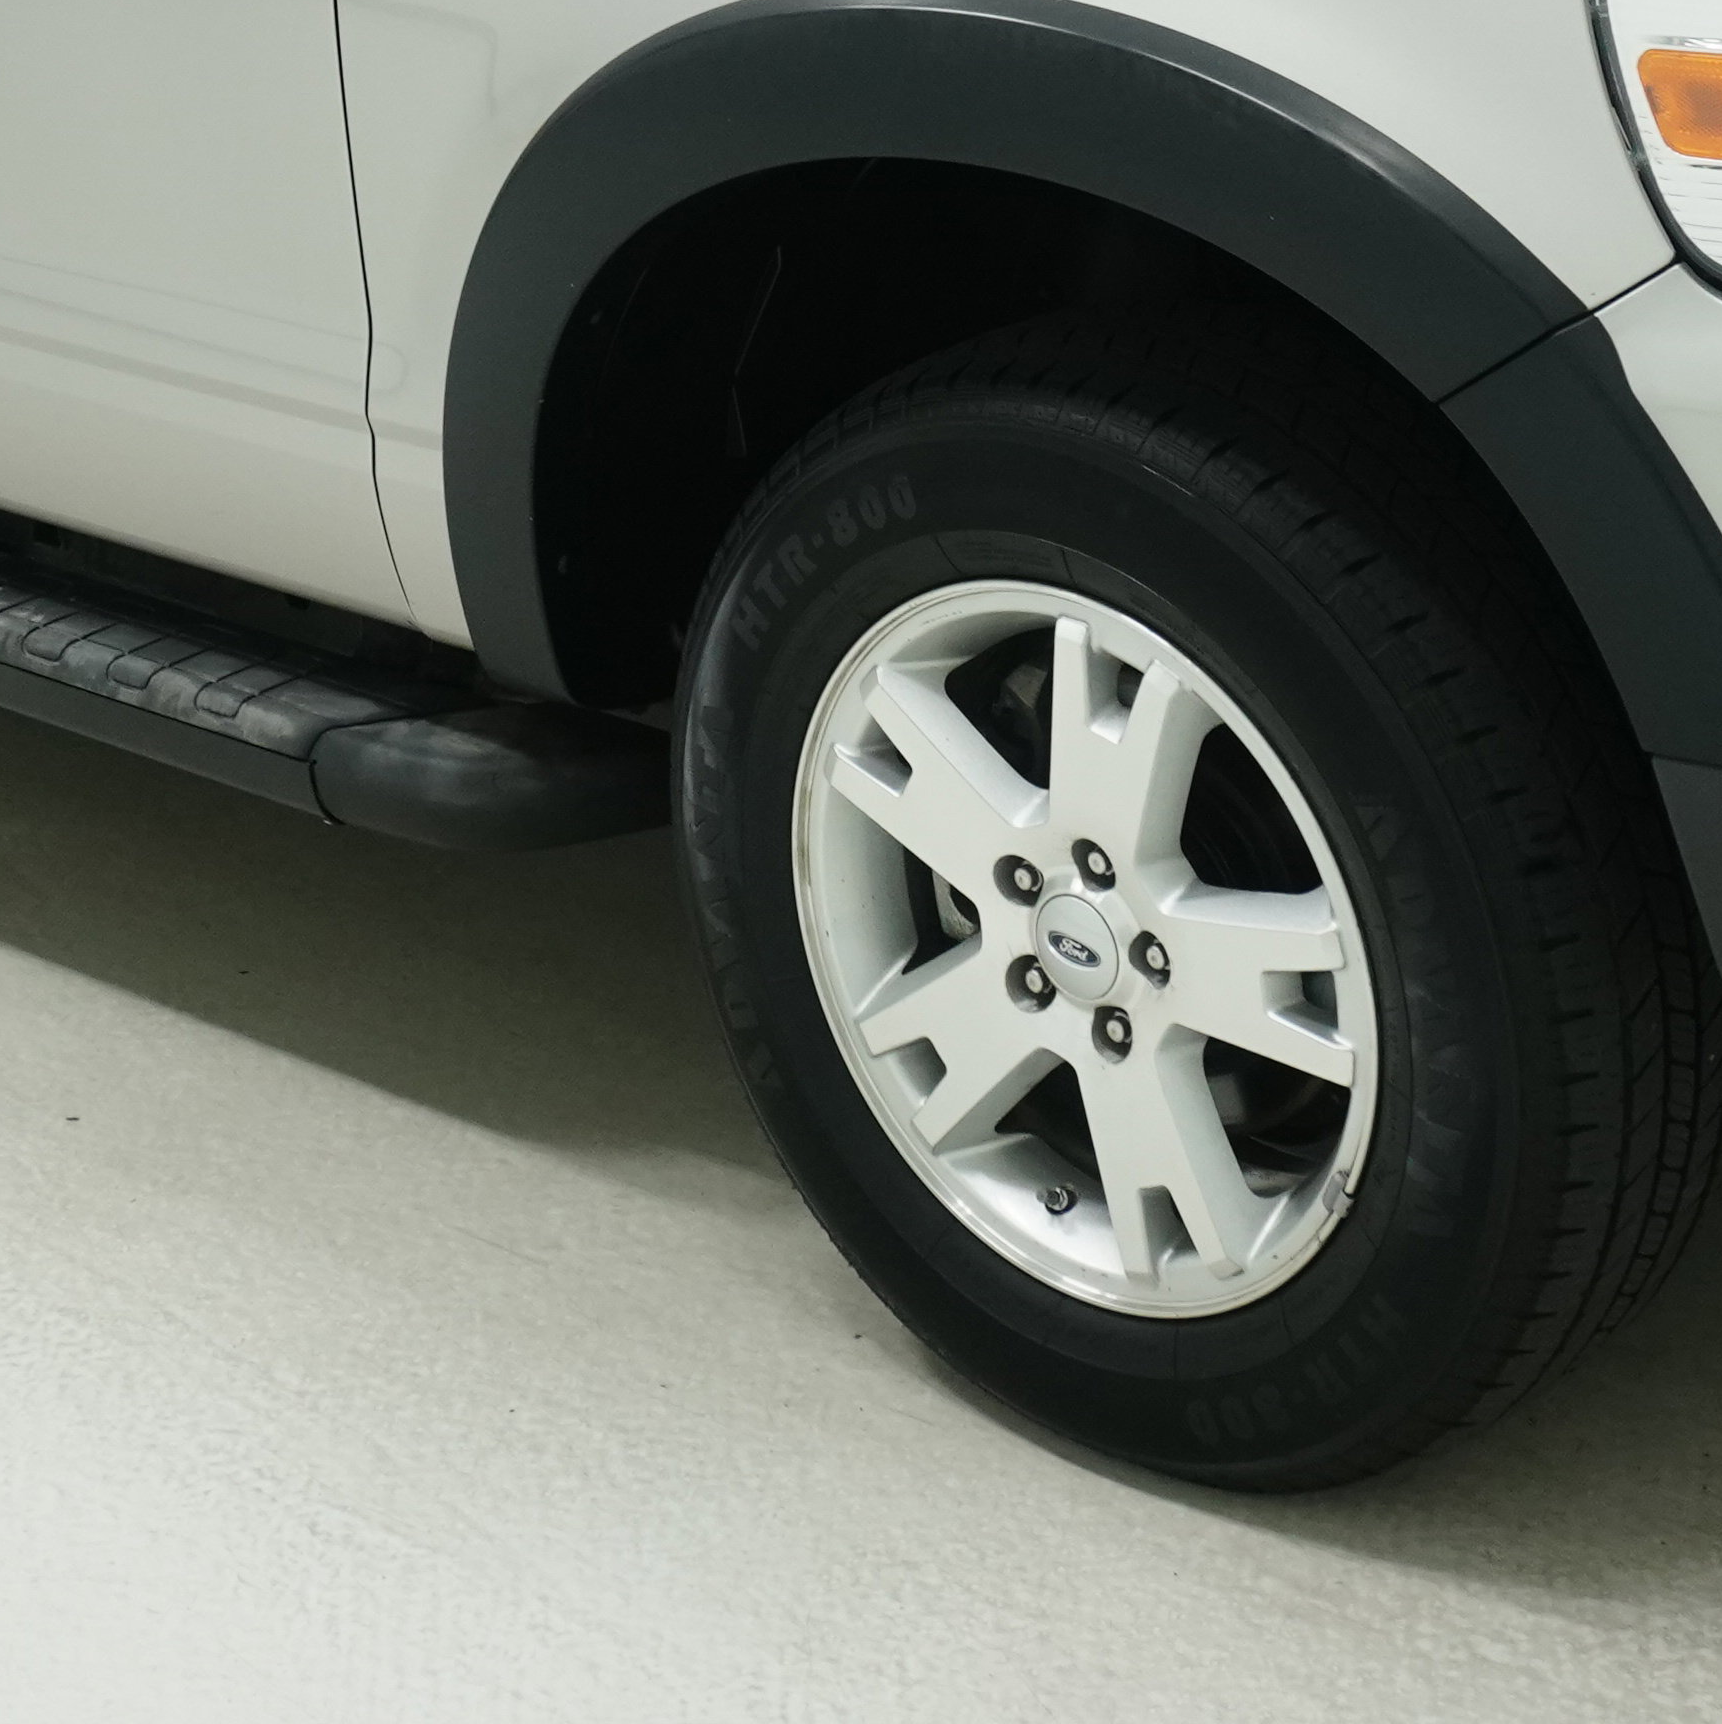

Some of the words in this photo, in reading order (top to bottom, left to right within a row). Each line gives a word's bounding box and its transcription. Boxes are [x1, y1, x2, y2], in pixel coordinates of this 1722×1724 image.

[730, 473, 917, 651] HTR-800
[1058, 937, 1089, 962] Ford
[1186, 1291, 1411, 1447] HTR-800
